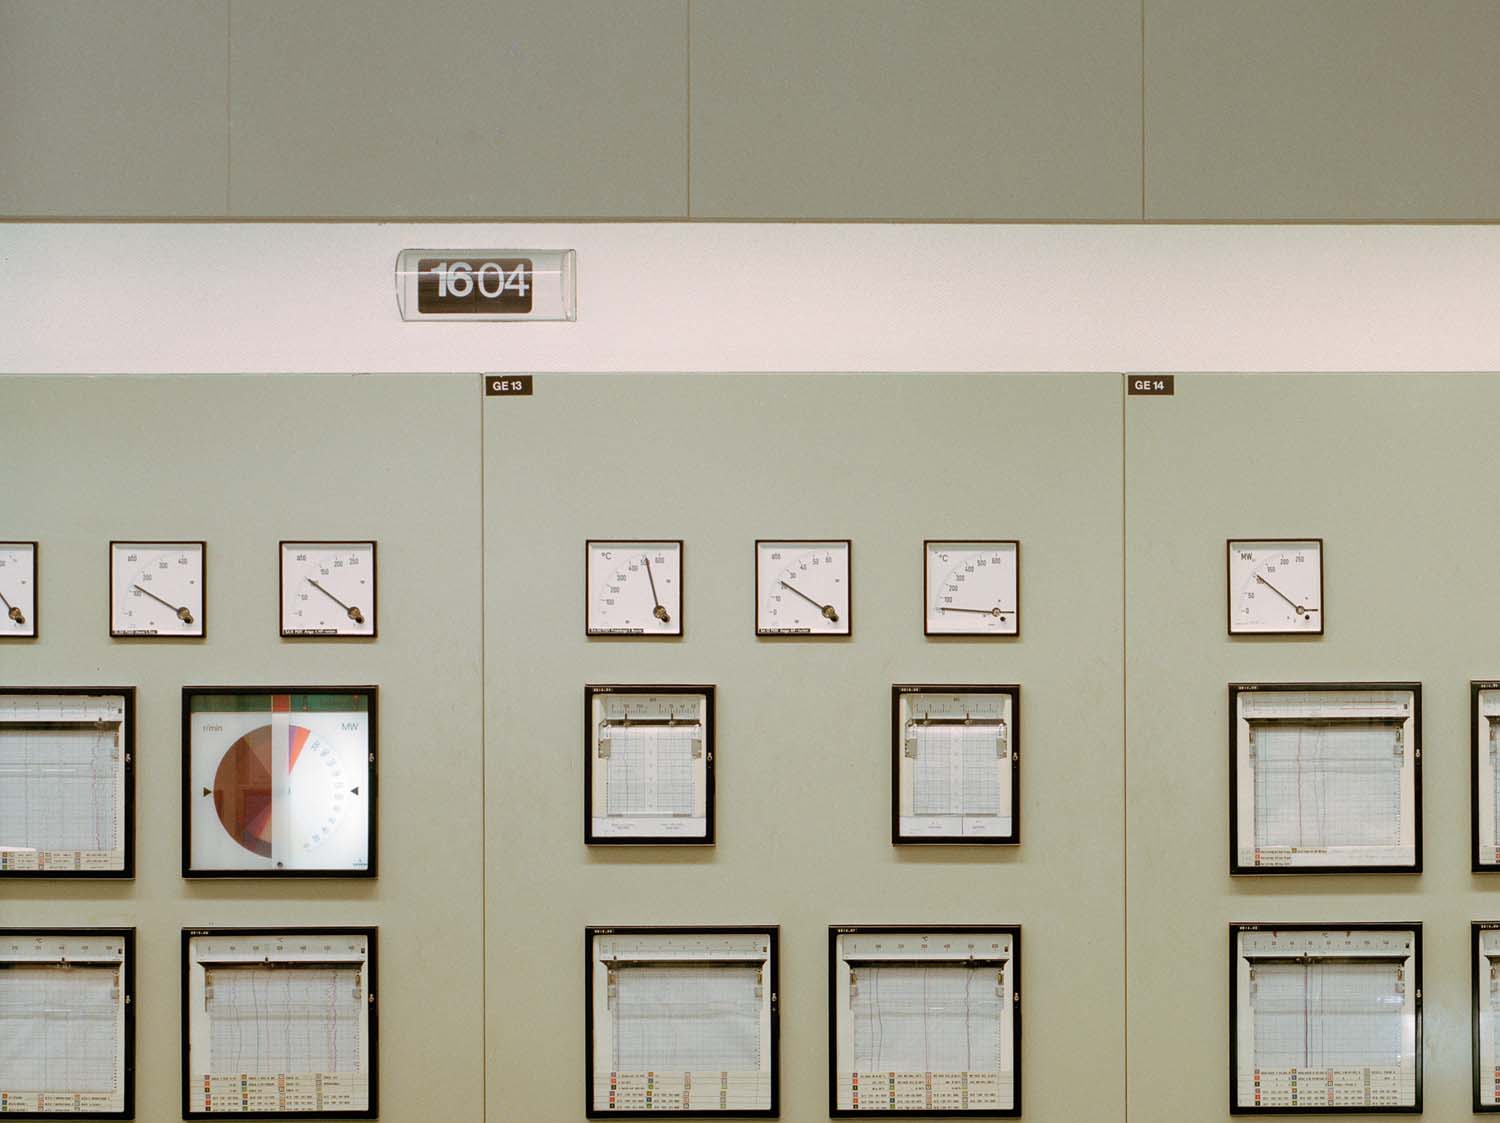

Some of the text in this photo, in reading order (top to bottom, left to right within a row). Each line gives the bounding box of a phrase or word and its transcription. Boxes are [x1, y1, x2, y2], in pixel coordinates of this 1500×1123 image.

[431, 262, 529, 298] 16 04
[493, 381, 522, 391] GE 13
[1135, 381, 1164, 390] GE 14
[601, 552, 612, 560] °C
[939, 554, 948, 562] °C
[1241, 552, 1252, 560] MW
